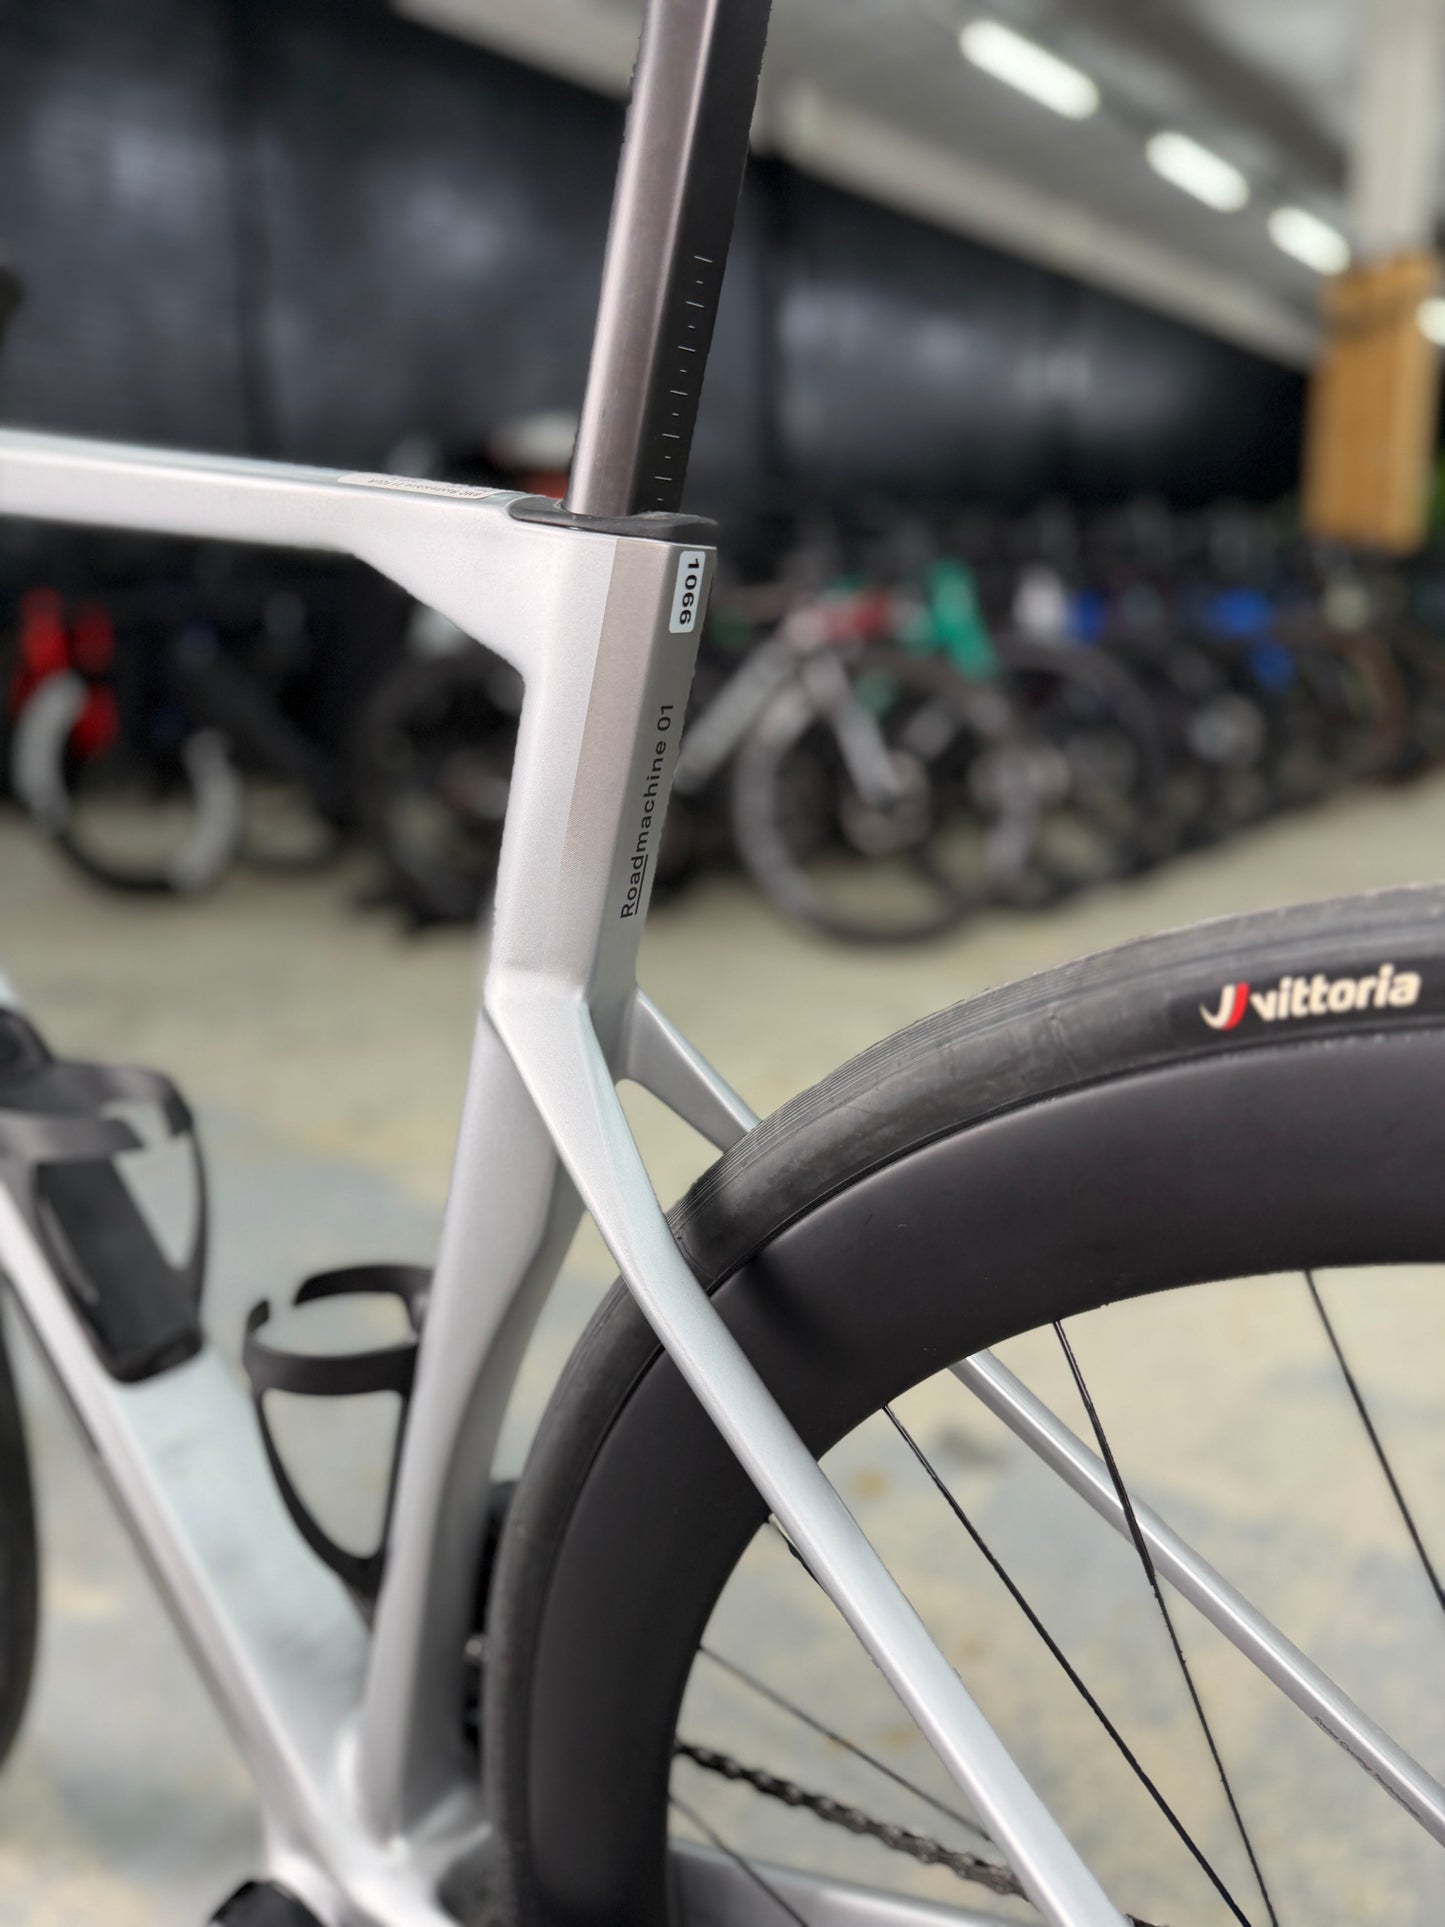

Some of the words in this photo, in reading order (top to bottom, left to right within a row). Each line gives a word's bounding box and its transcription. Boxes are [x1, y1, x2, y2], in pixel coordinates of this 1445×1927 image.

[678, 557, 700, 626] 1066
[620, 741, 668, 919] Roadmachine
[656, 704, 674, 731] 01
[1249, 963, 1422, 1022] vittoria
